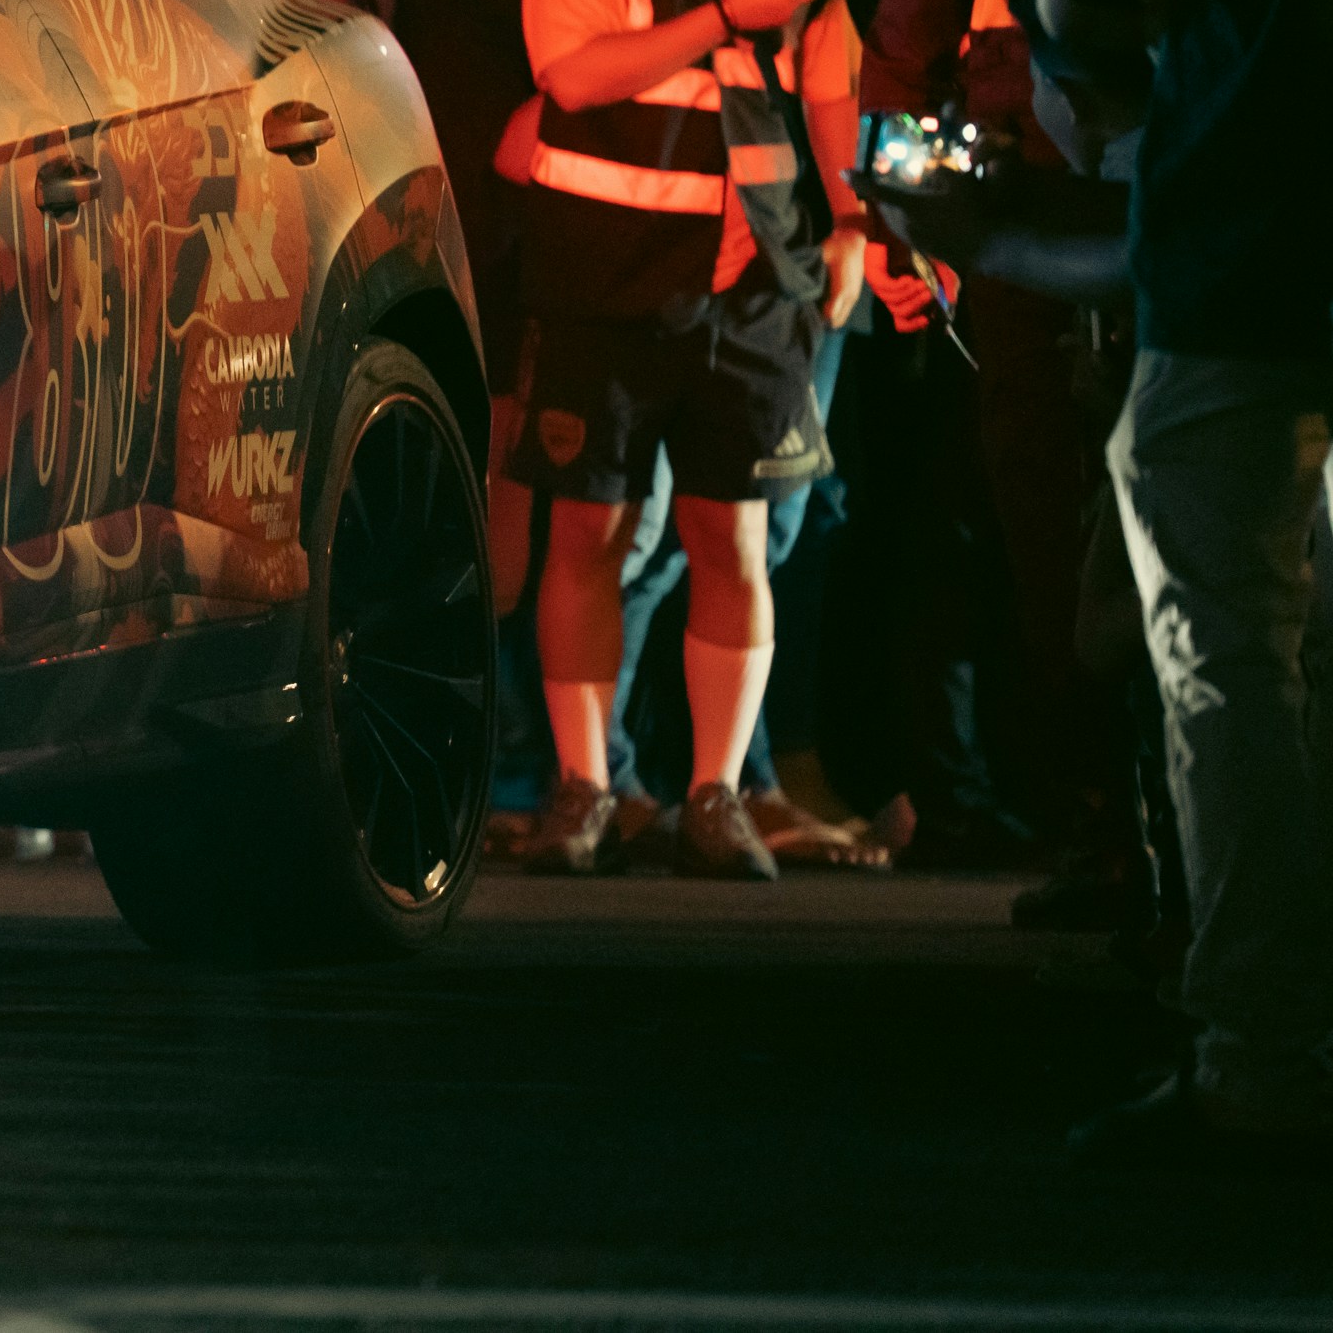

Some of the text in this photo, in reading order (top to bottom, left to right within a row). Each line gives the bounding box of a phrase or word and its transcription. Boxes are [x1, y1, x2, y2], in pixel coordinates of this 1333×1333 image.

[204, 332, 295, 384] CAMBODIA
[219, 385, 285, 412] WATER
[207, 429, 298, 499] WURKZ
